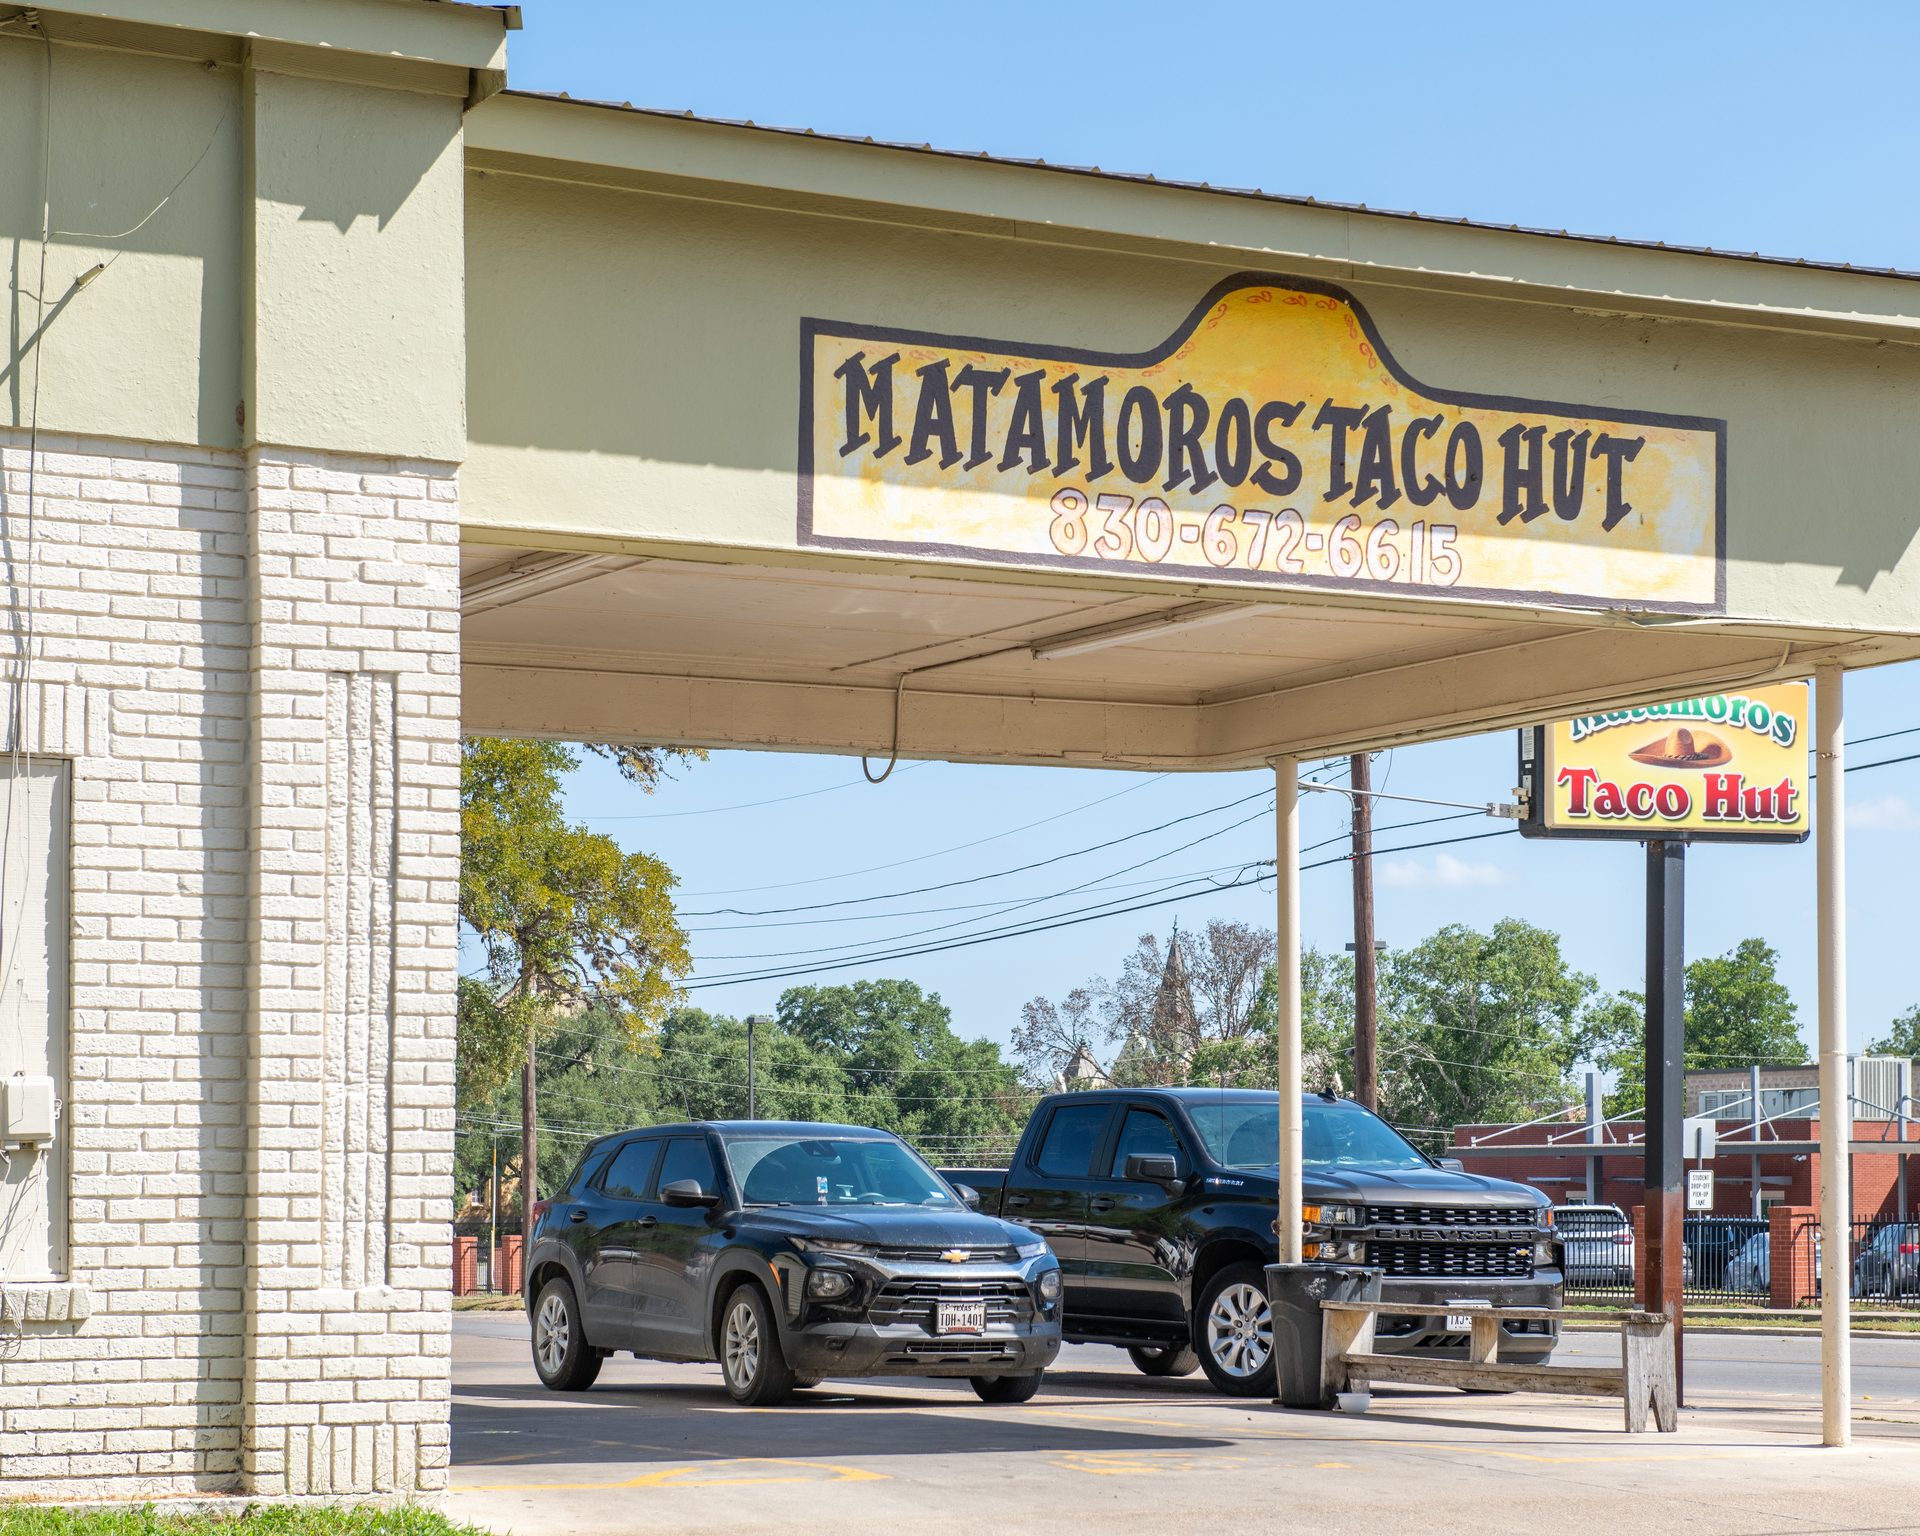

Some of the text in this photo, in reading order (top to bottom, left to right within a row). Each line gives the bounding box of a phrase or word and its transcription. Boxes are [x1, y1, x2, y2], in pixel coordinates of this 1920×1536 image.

[833, 350, 1646, 533] MATAMOROS TACO HUT
[1048, 486, 1463, 587] 830-672-6615
[1557, 766, 1798, 821] Taco Hut
[1374, 1228, 1537, 1241] CHEVROLET
